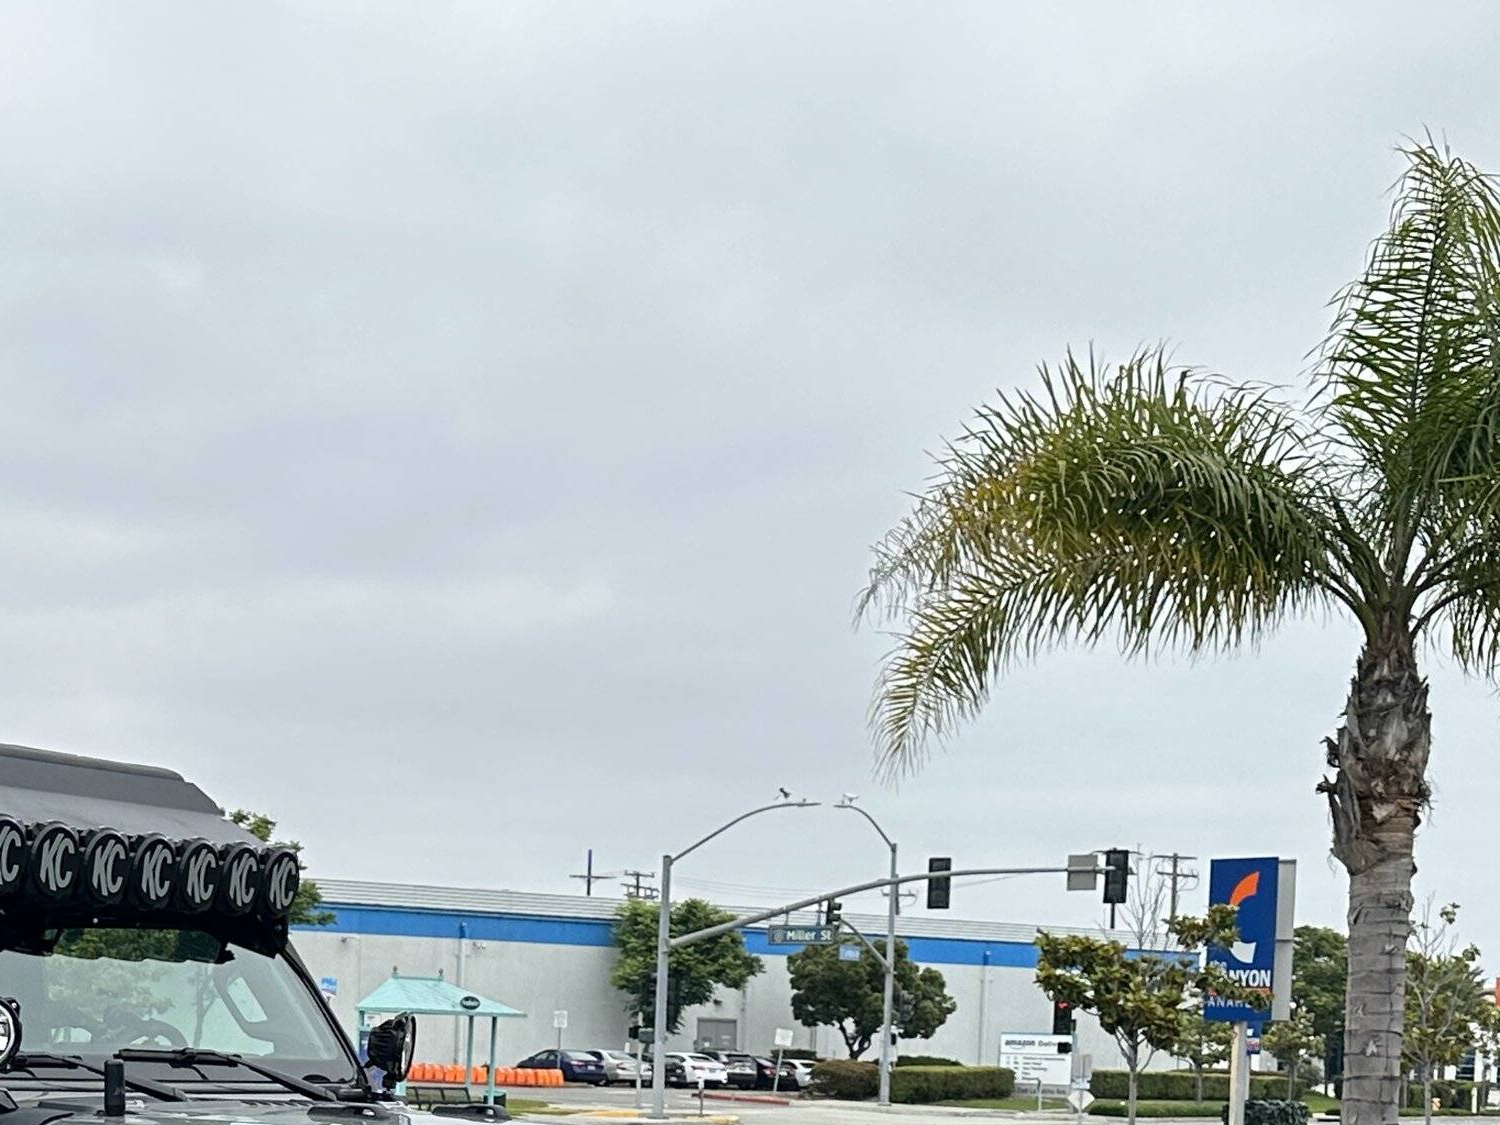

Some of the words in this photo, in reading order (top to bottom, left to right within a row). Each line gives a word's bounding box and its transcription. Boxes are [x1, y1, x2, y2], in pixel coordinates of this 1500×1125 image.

[39, 833, 76, 891] KC
[92, 839, 126, 896] KC
[141, 844, 173, 900] KC
[186, 849, 217, 904] KC
[229, 853, 258, 907] KC
[269, 857, 297, 910] KC
[787, 930, 817, 941] Miller
[820, 930, 832, 941] St
[1224, 969, 1271, 987] NYON
